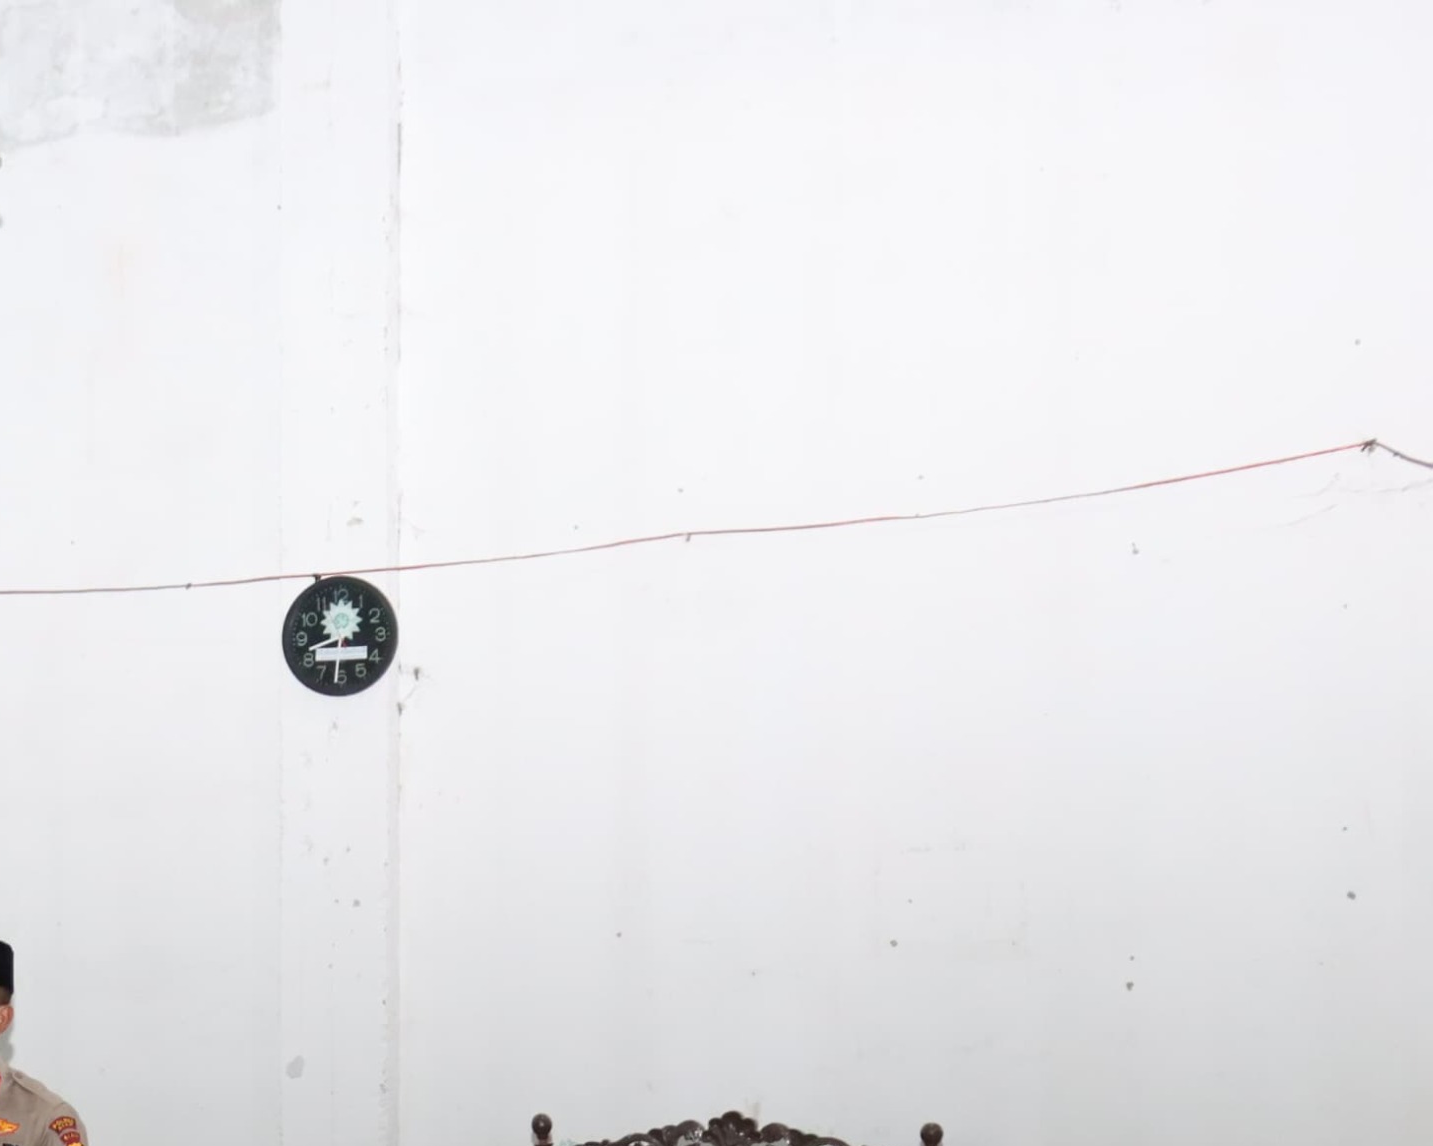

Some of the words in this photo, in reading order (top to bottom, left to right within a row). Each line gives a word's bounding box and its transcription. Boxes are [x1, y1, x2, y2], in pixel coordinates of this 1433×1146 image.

[334, 588, 349, 604] 12
[317, 597, 326, 611] 11
[302, 612, 318, 627] 10
[369, 608, 380, 623] 2
[296, 631, 308, 646] 9
[375, 626, 387, 641] 3
[303, 652, 315, 667] 8
[368, 648, 381, 664] 4
[316, 665, 326, 680] 7
[355, 663, 367, 677] 5
